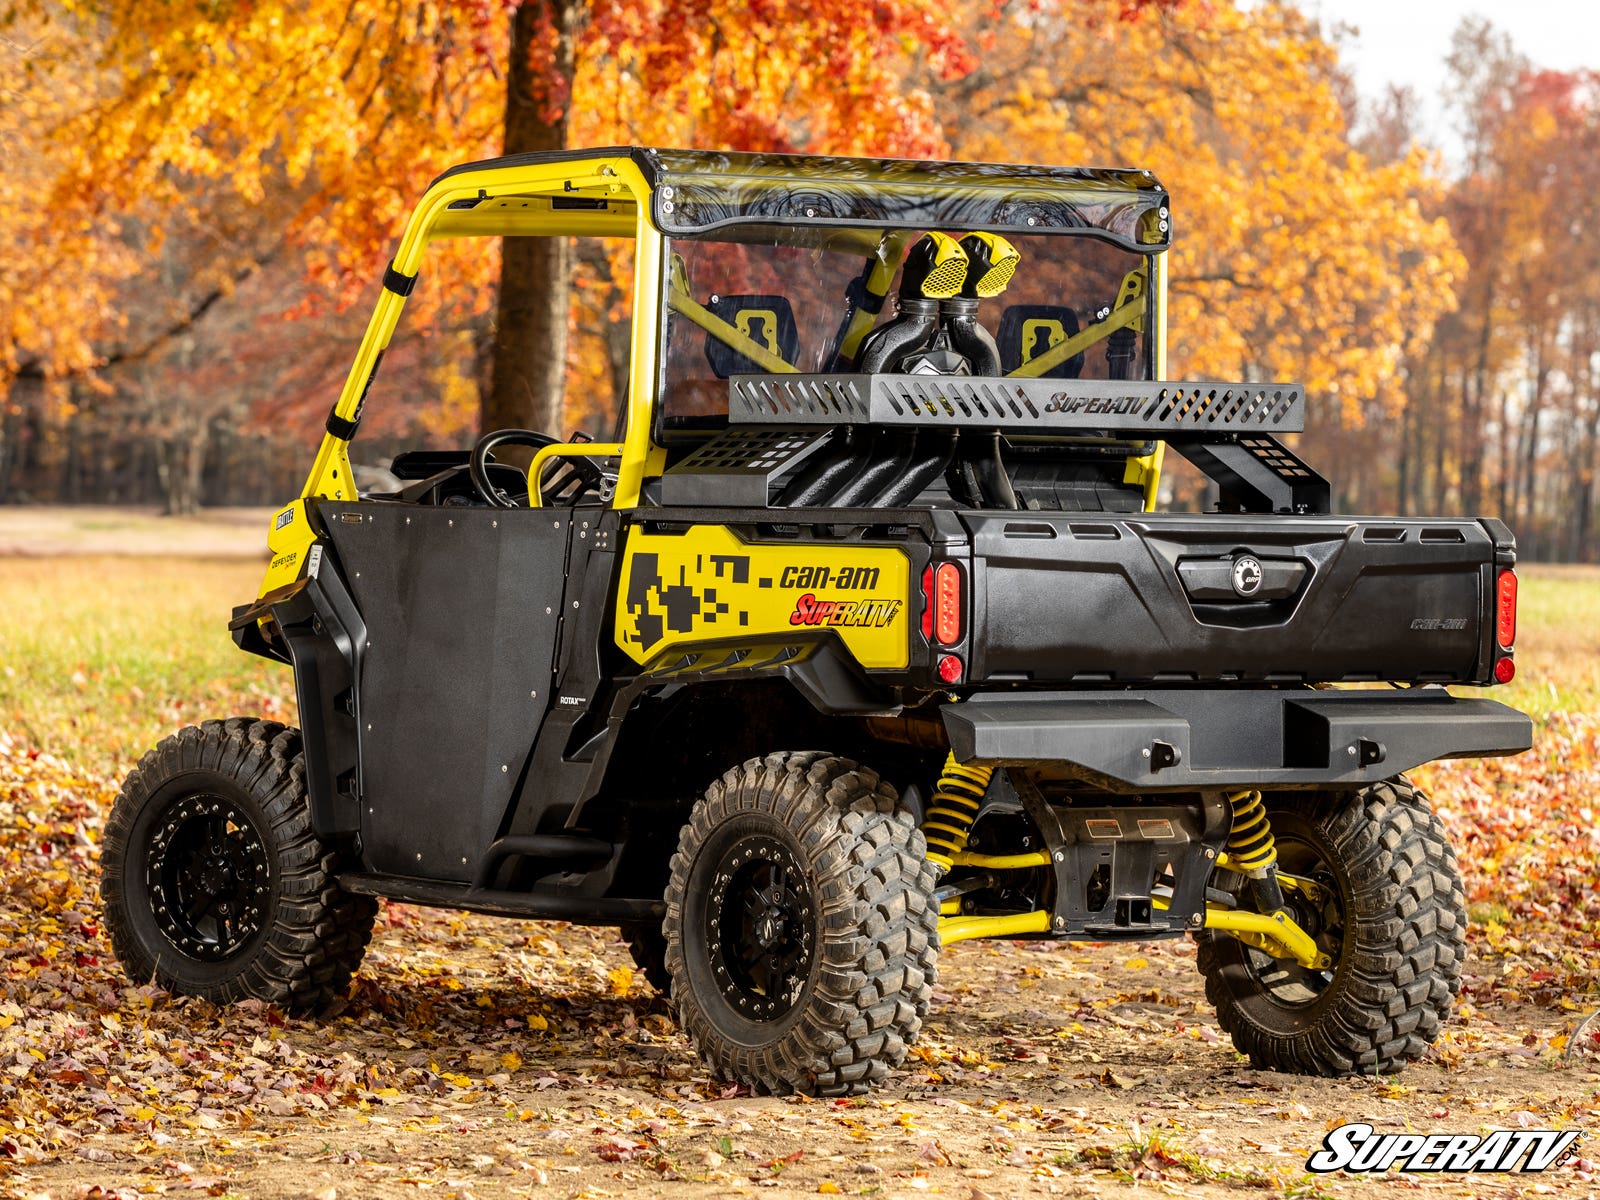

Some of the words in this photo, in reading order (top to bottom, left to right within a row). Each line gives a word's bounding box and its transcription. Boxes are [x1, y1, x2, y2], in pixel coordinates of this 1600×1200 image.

[271, 552, 297, 569] DEFENDER
[779, 565, 880, 590] can-am
[1410, 617, 1469, 630] can-am
[560, 696, 579, 706] ROTAX
